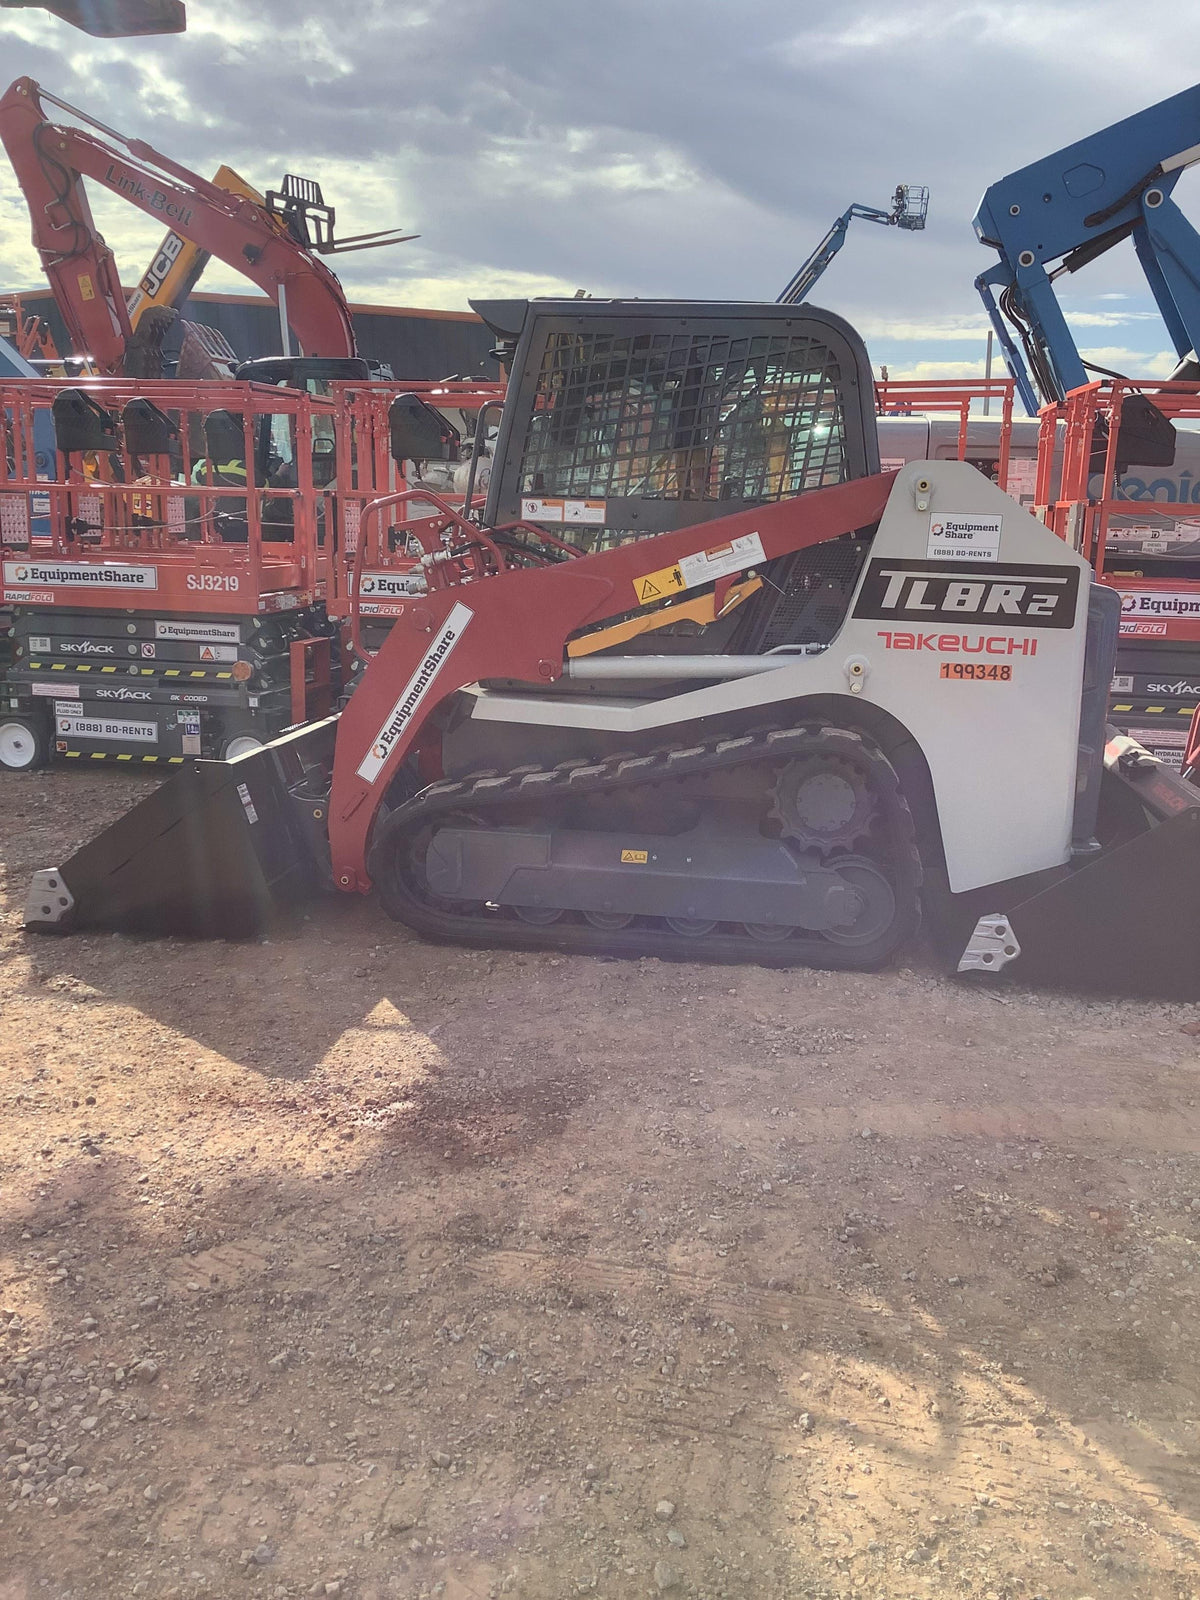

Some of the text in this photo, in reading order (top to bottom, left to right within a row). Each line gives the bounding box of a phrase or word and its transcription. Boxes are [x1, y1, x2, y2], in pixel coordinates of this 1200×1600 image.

[105, 164, 194, 226] Link-Belt
[146, 233, 186, 296] JCB
[946, 521, 999, 532] Equipment
[945, 530, 973, 540] Share
[933, 548, 954, 557] (888)
[30, 567, 145, 583] EquipmentShare
[186, 574, 239, 592] SJ3219
[168, 626, 235, 637] EquipmentShare
[60, 641, 115, 653] SKYJACK
[942, 663, 1011, 681] 199348
[96, 688, 152, 700] SKYJACK
[380, 629, 455, 745] EquipmentShare
[75, 722, 153, 736] (888) 80-RENTS
